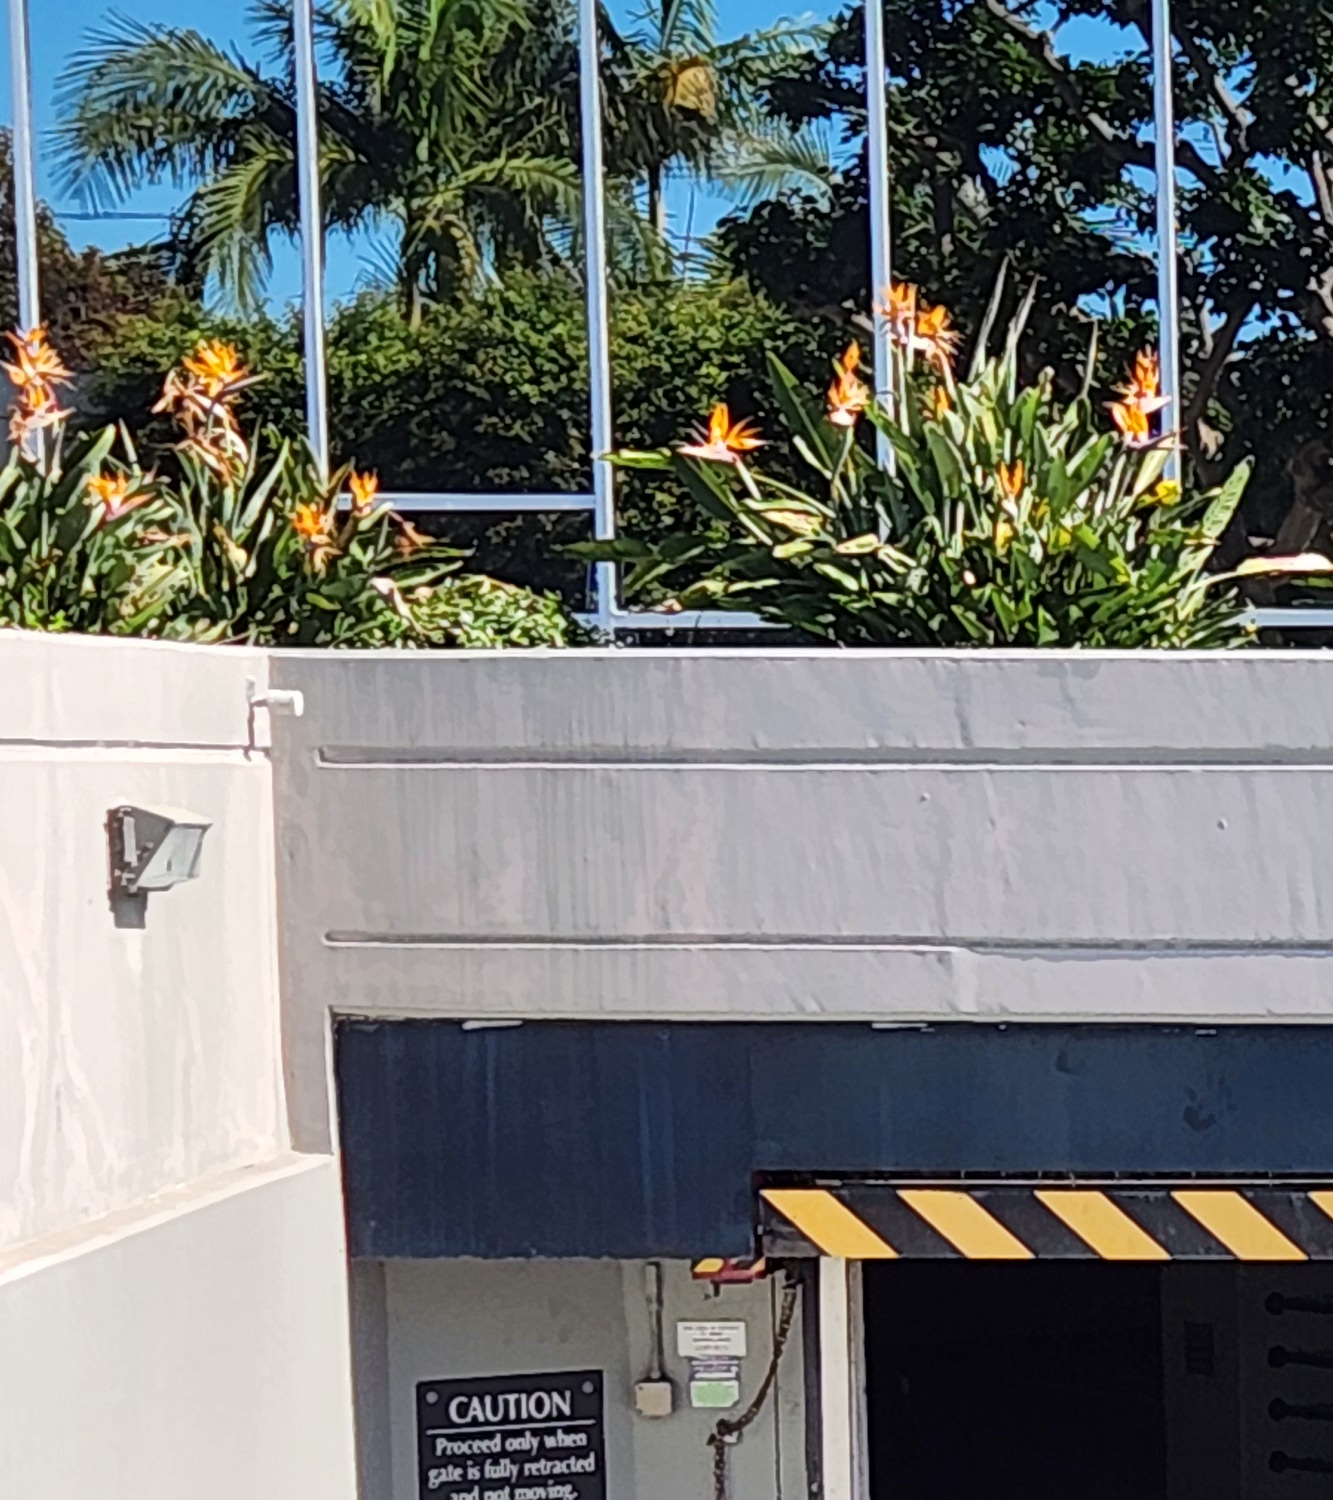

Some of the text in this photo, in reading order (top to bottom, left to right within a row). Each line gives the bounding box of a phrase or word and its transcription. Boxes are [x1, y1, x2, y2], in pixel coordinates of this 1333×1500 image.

[449, 1390, 571, 1423] CAUTION
[436, 1430, 587, 1455] Proceed only when
[428, 1451, 595, 1489] gate is fully retracted
